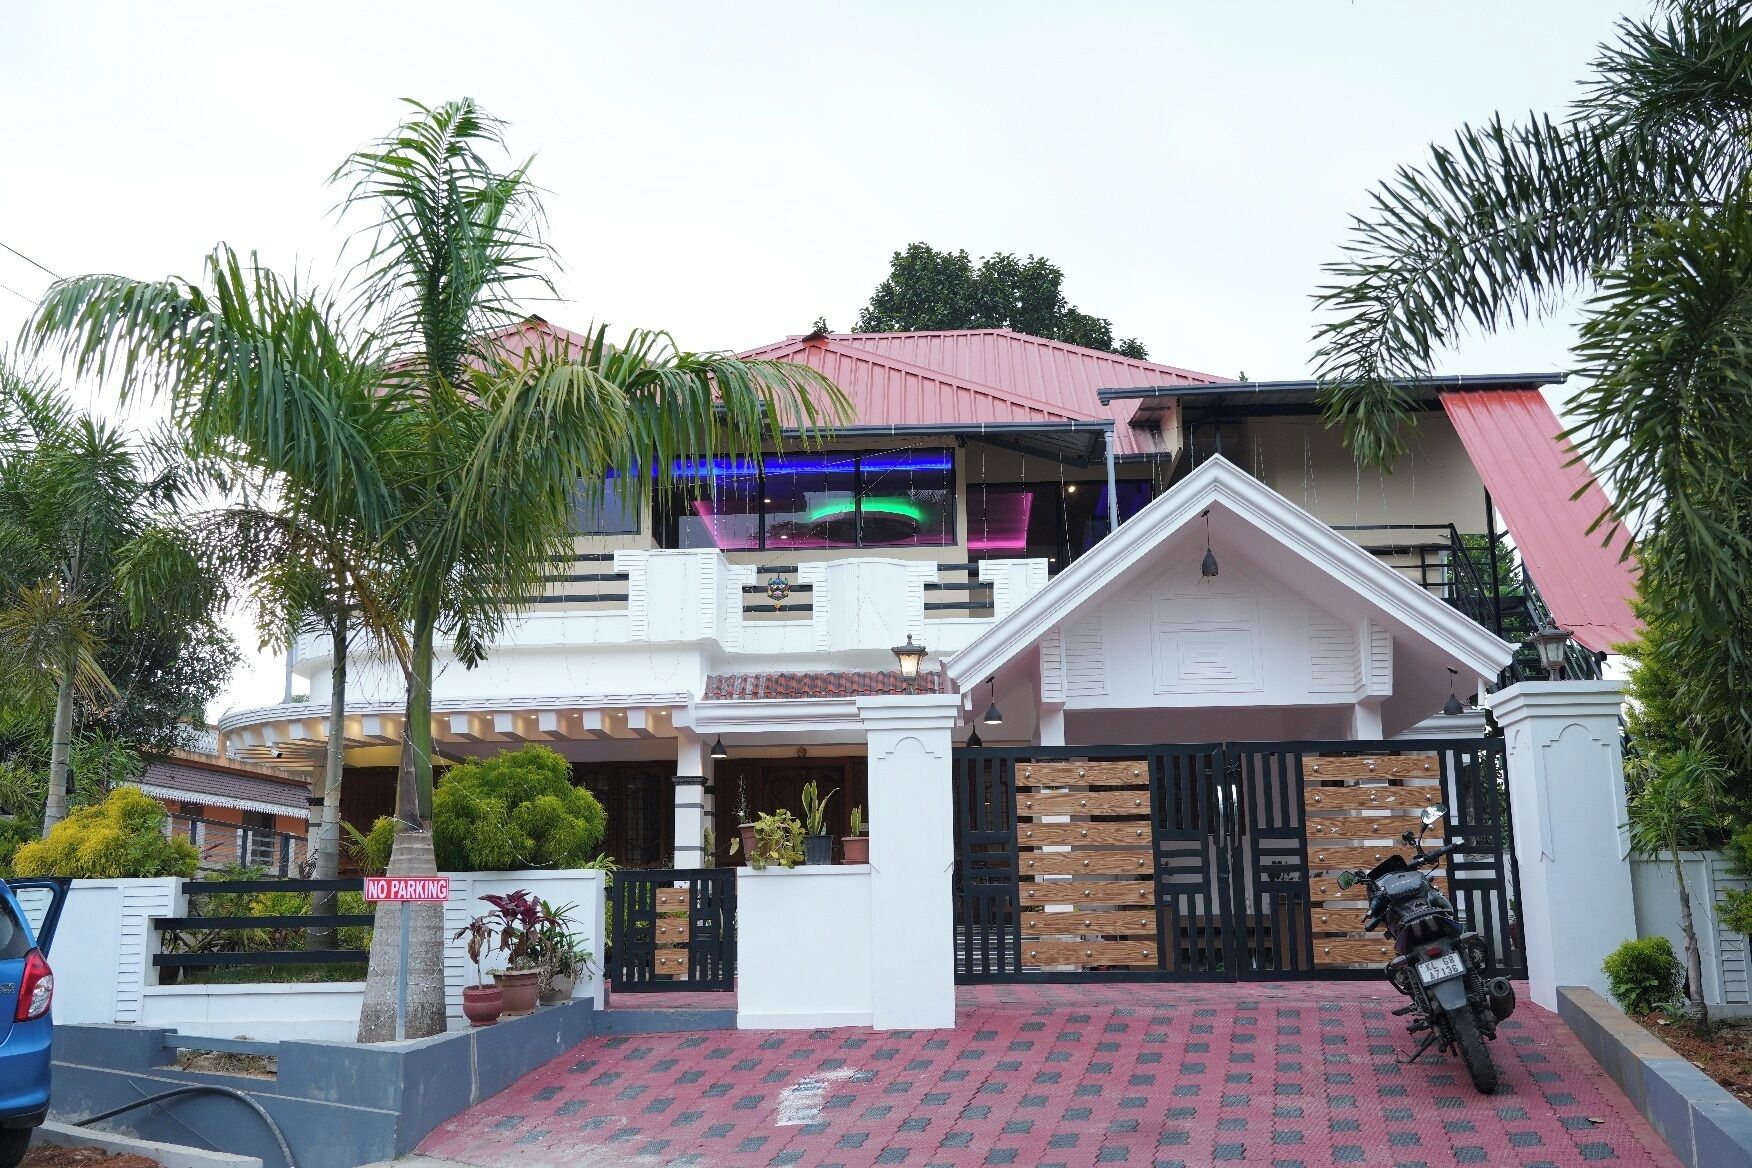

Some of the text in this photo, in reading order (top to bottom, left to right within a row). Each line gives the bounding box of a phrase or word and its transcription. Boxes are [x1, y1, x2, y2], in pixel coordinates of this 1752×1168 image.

[368, 880, 447, 899] NO PARKING
[1424, 955, 1455, 971] KL 68
